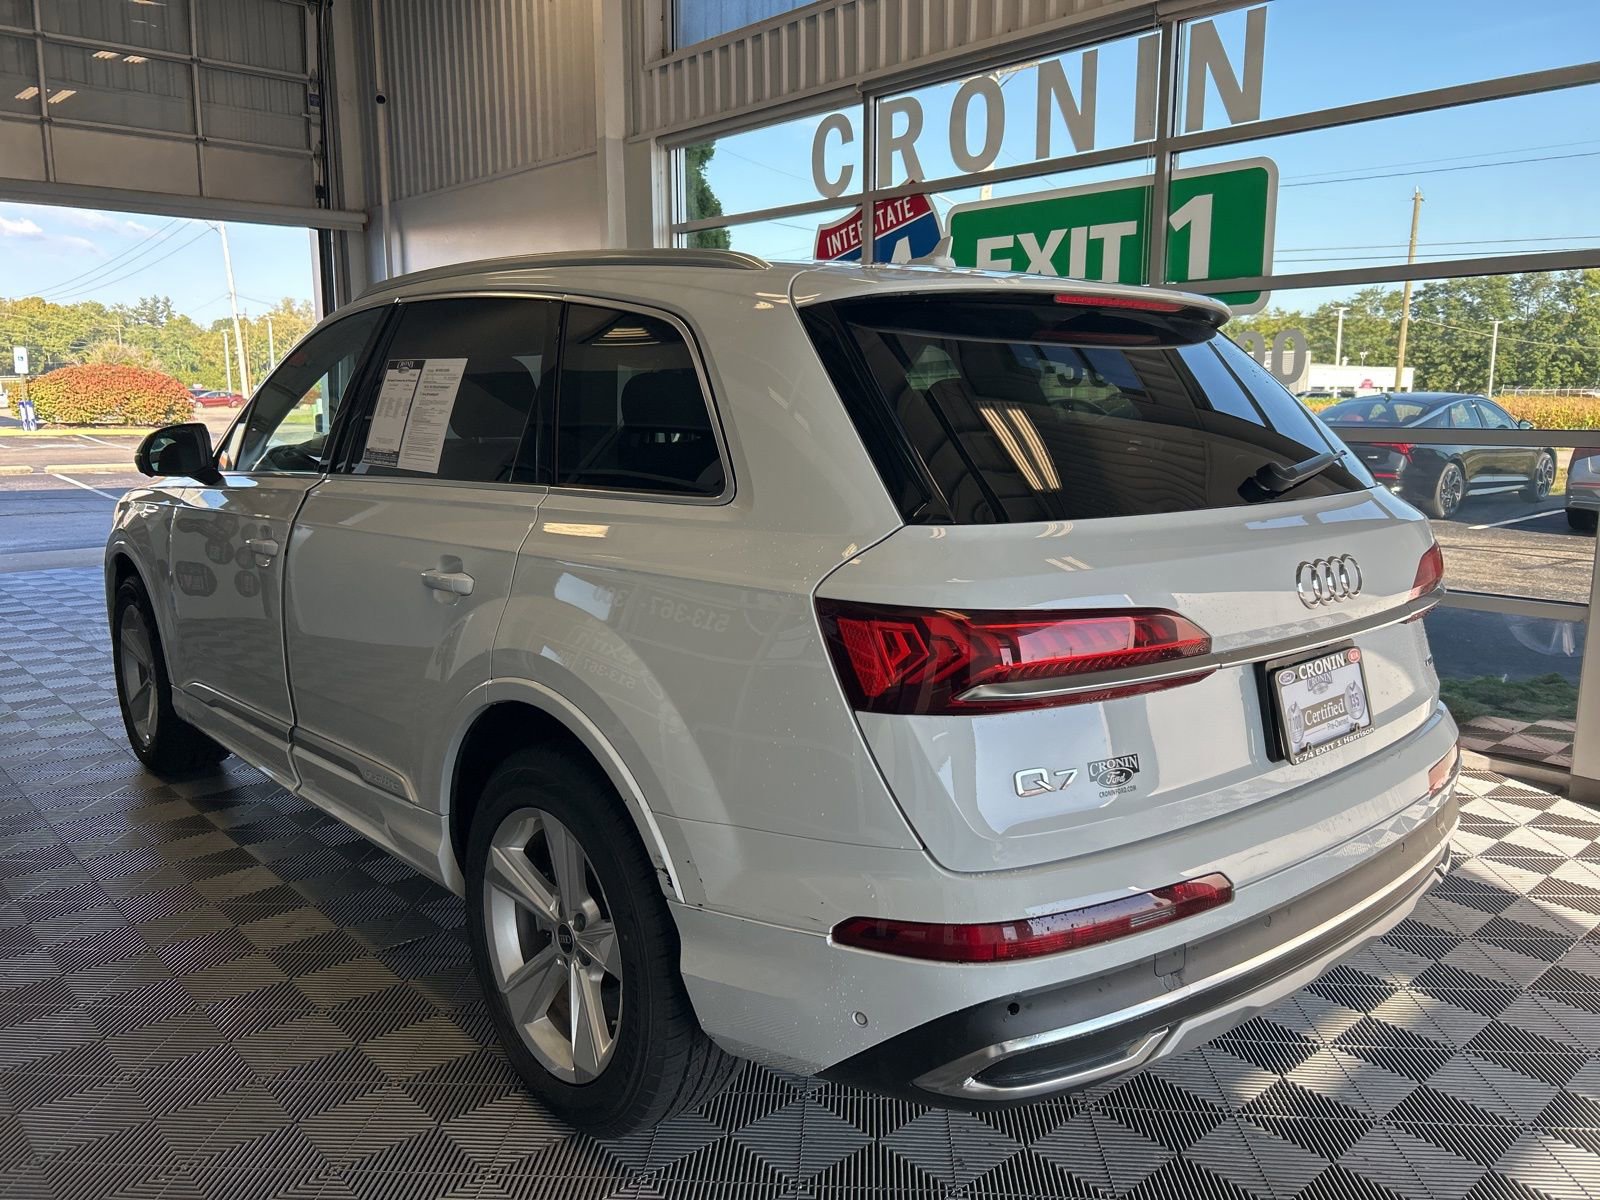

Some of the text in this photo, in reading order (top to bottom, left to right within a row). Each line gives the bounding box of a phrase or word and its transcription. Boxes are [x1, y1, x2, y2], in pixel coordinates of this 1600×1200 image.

[811, 6, 1267, 199] CRONIN
[826, 197, 914, 257] INTERTATE
[976, 220, 1138, 284] EXIT
[1169, 193, 1213, 280] 1
[1299, 653, 1345, 680] CRONIN
[1304, 698, 1345, 726] Certified
[1295, 751, 1314, 764] I-74
[1315, 743, 1335, 756] EXIT
[1343, 727, 1375, 744] Harrison
[1089, 754, 1138, 777] CRONIN
[1105, 770, 1126, 785] Ford
[1013, 767, 1078, 798] Q7
